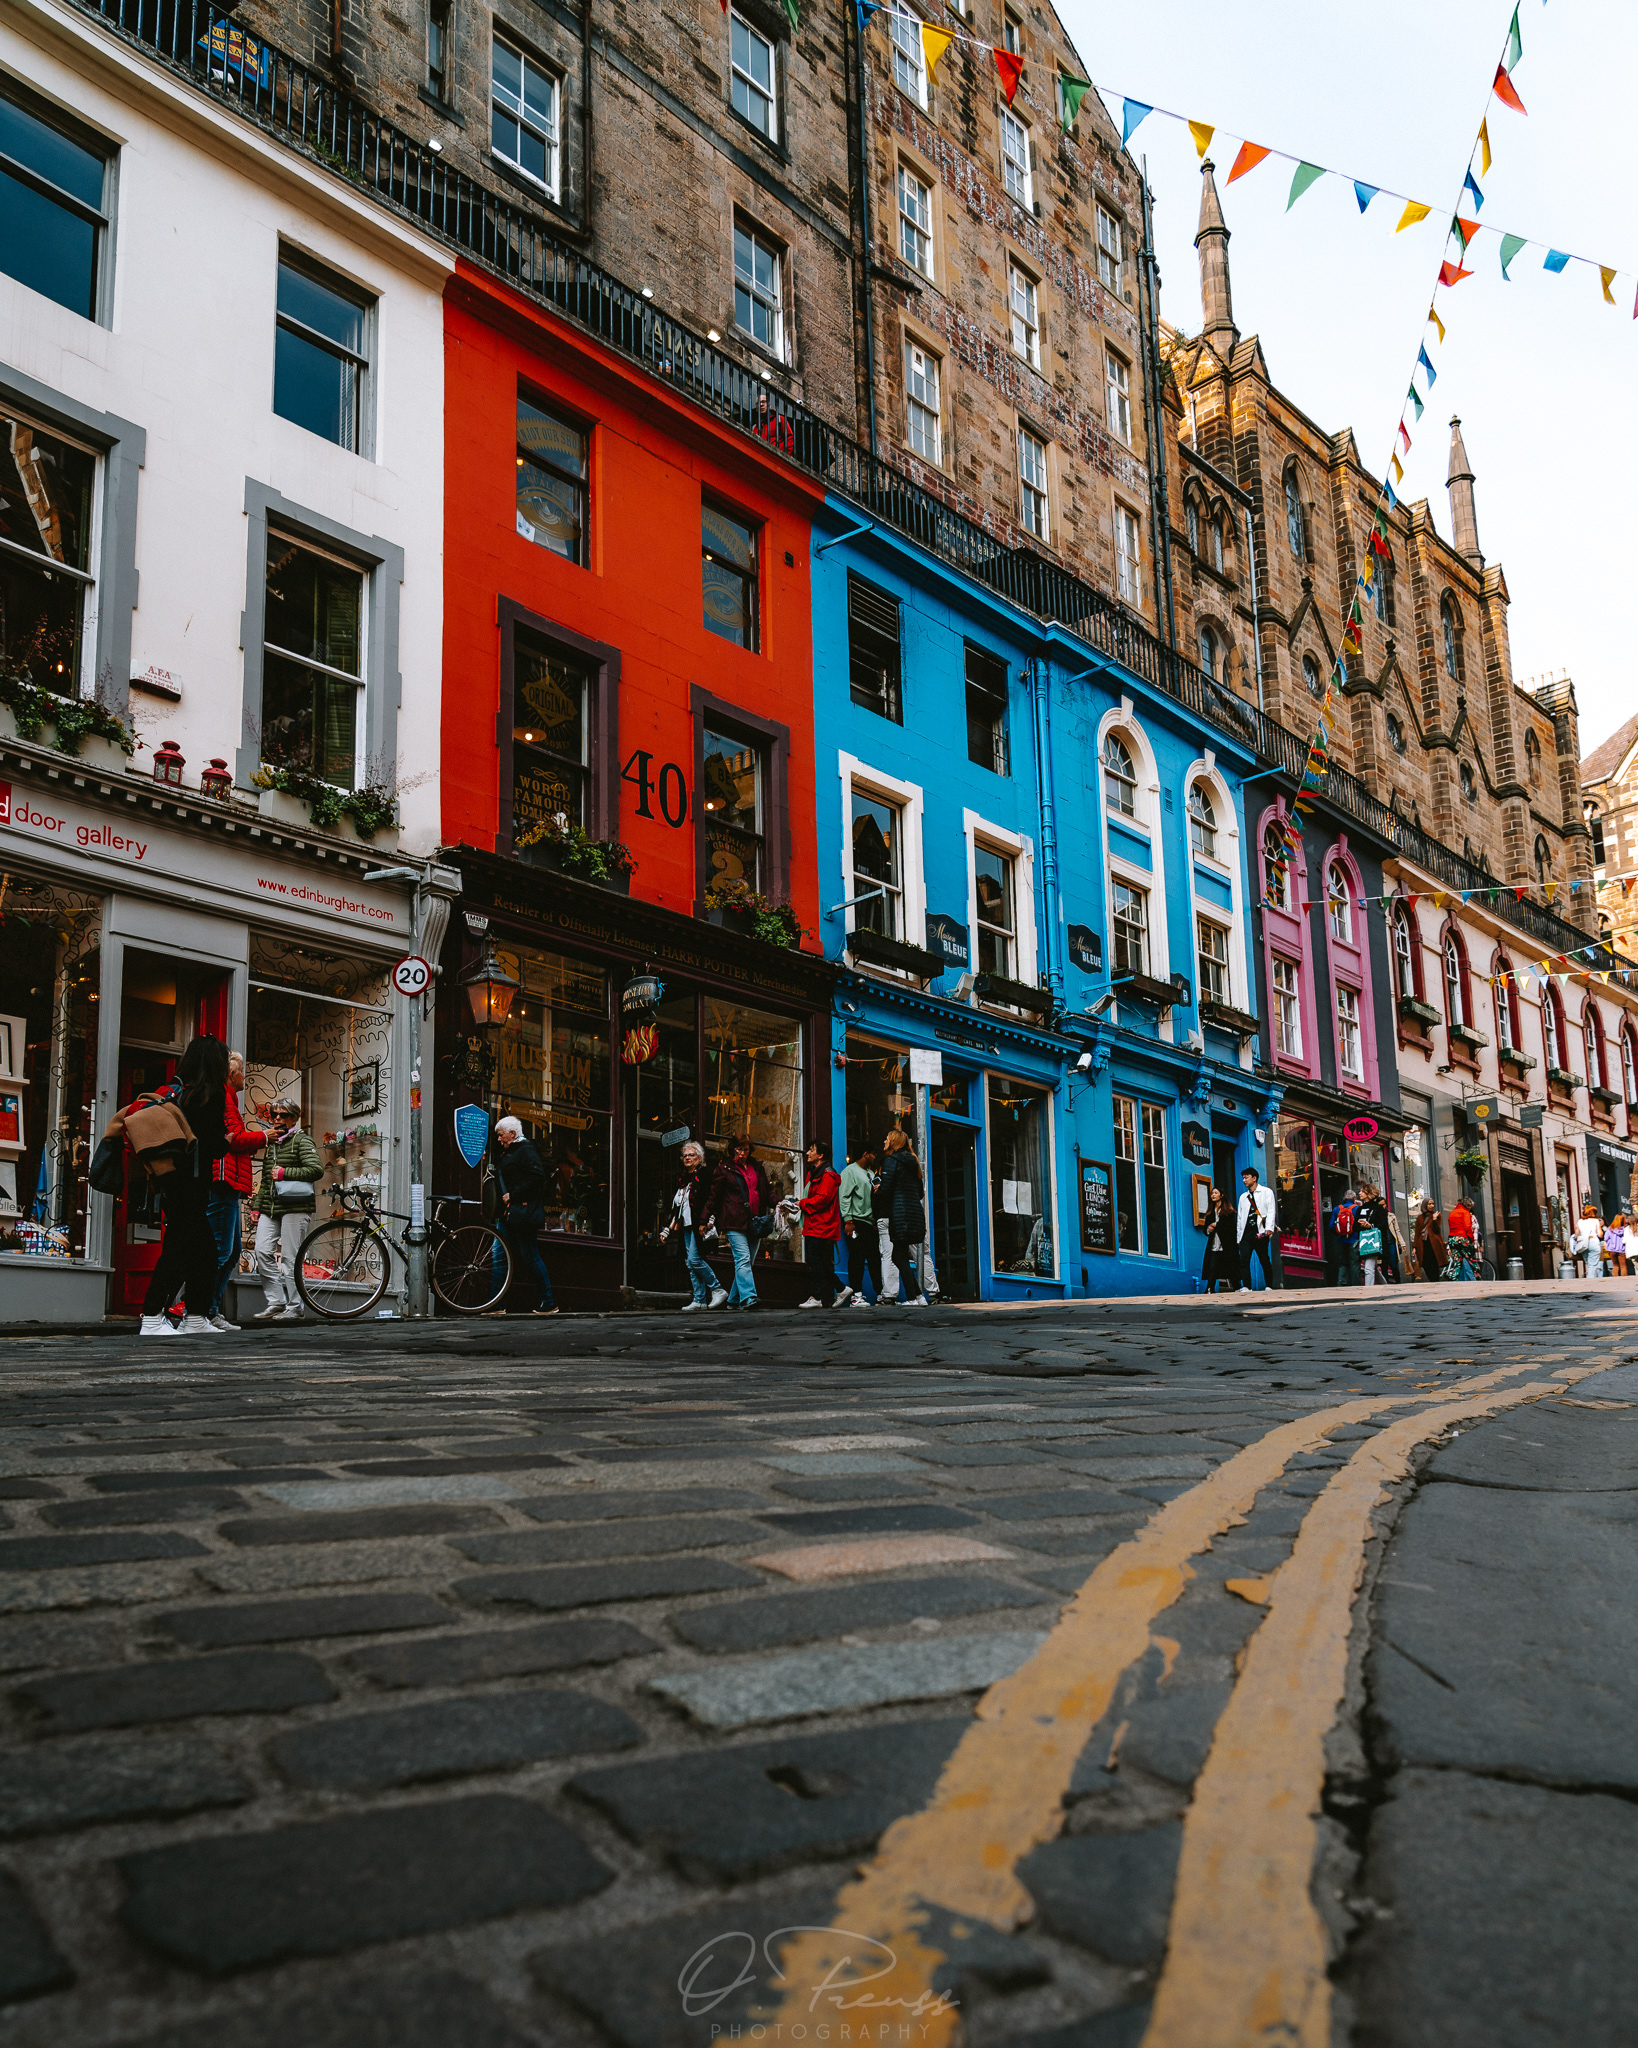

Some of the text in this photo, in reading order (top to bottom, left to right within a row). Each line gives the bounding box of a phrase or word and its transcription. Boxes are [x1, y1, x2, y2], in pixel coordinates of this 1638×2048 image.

[234, 32, 254, 50] BR
[541, 427, 559, 443] OUR
[529, 686, 571, 716] ORIGINAL
[519, 775, 571, 802] WORLD
[621, 749, 687, 828] 40
[15, 802, 66, 832] door
[76, 825, 147, 860] gallery
[493, 893, 808, 998] Retailer of Officially Licensed HARRY POTTER Merchandise
[943, 940, 967, 959] BLEUE
[1082, 951, 1102, 968] BLEUE
[399, 967, 425, 985] 20
[502, 1040, 591, 1089] MUSEUM
[519, 1075, 575, 1101] CONTEXT
[721, 1090, 790, 1131] MUSEUM
[1599, 1143, 1611, 1156] THE
[1610, 1147, 1632, 1162] WHISKY
[304, 1257, 324, 1266] oor
